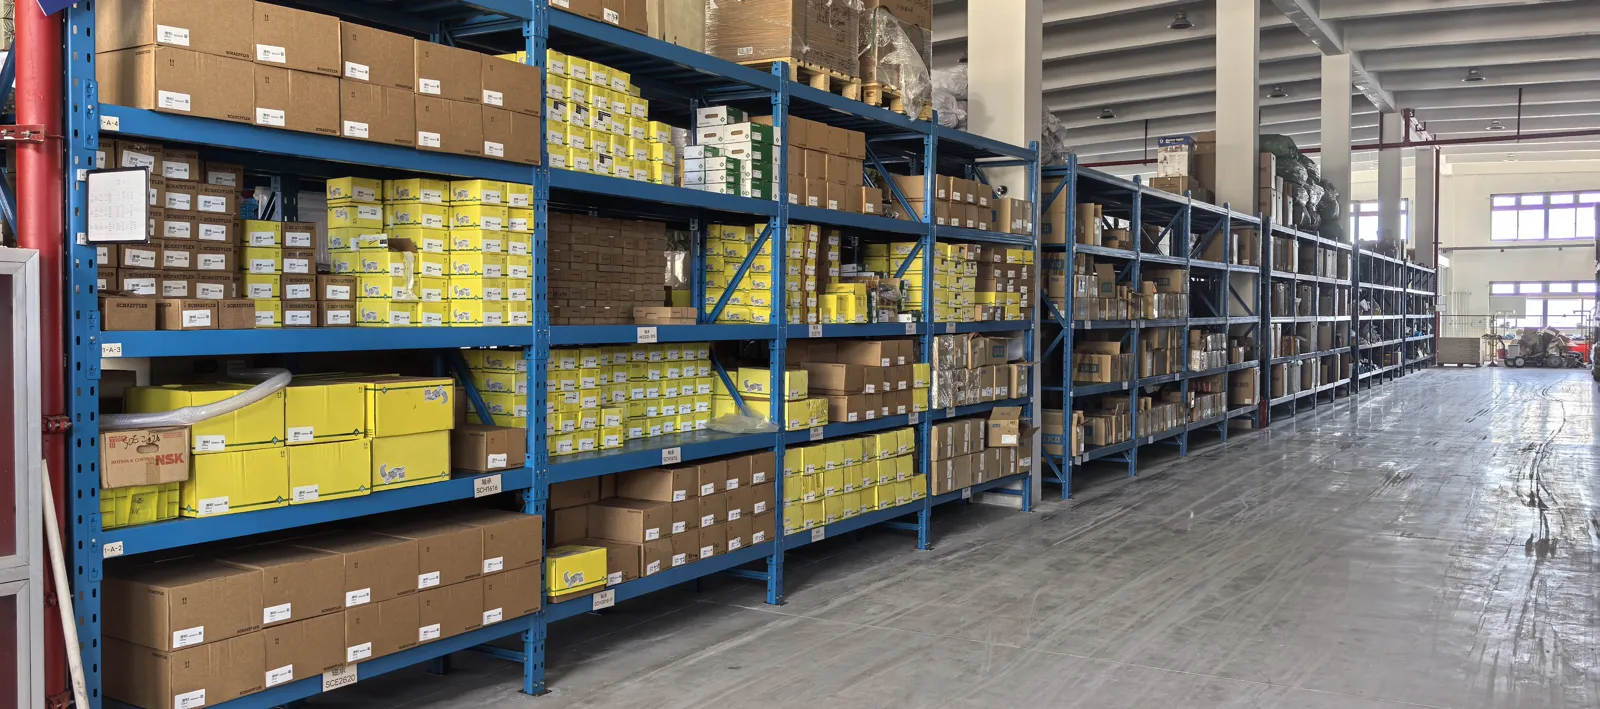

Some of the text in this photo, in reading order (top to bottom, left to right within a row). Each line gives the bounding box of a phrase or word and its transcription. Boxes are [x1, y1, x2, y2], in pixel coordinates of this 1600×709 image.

[155, 452, 185, 466] NSK
[104, 545, 122, 553] 1-A-2
[325, 673, 356, 689] SCE2620
